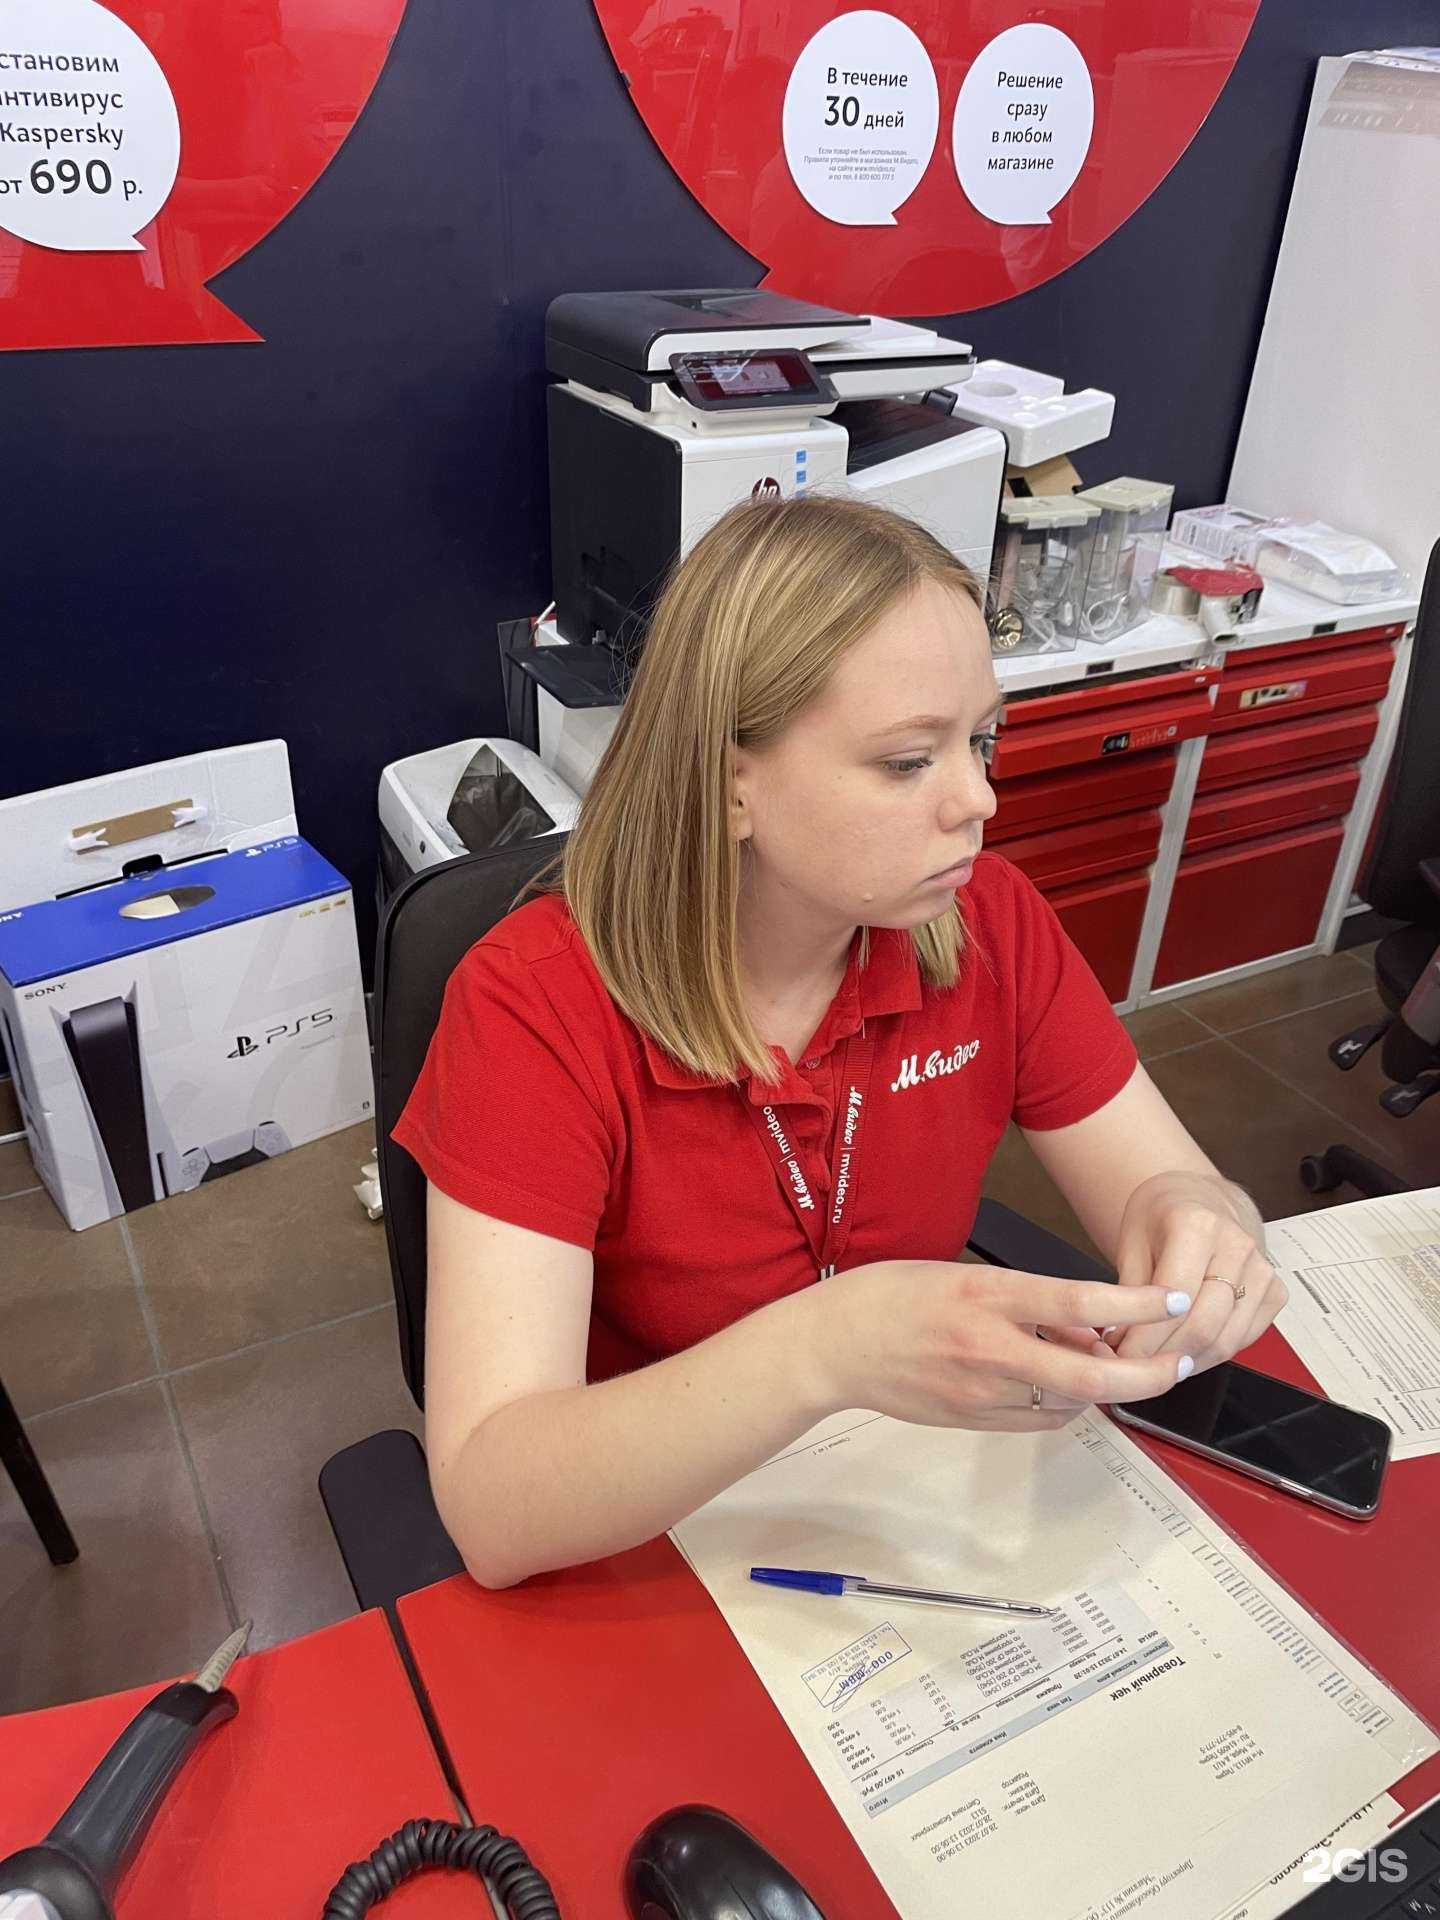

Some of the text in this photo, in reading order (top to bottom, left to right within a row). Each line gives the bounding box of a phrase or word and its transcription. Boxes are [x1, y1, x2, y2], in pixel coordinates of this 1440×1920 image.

[827, 67, 908, 87] В течение
[997, 71, 1063, 90] Решение
[0, 90, 123, 115] нтивирус
[1007, 101, 1048, 121] сразу
[824, 96, 904, 130] 30 дней
[1, 122, 123, 150] Kaspersky
[991, 128, 1053, 144] в любом
[987, 156, 1054, 171] магазине
[0, 159, 143, 200] от 690 р.
[24, 983, 66, 1000] SONY
[265, 1008, 333, 1044] PS5
[832, 1153, 851, 1224] mvideo.ru
[870, 1650, 893, 1668] ООО
[1109, 1655, 1185, 1701] Товарный чек
[868, 1797, 888, 1811] Итого
